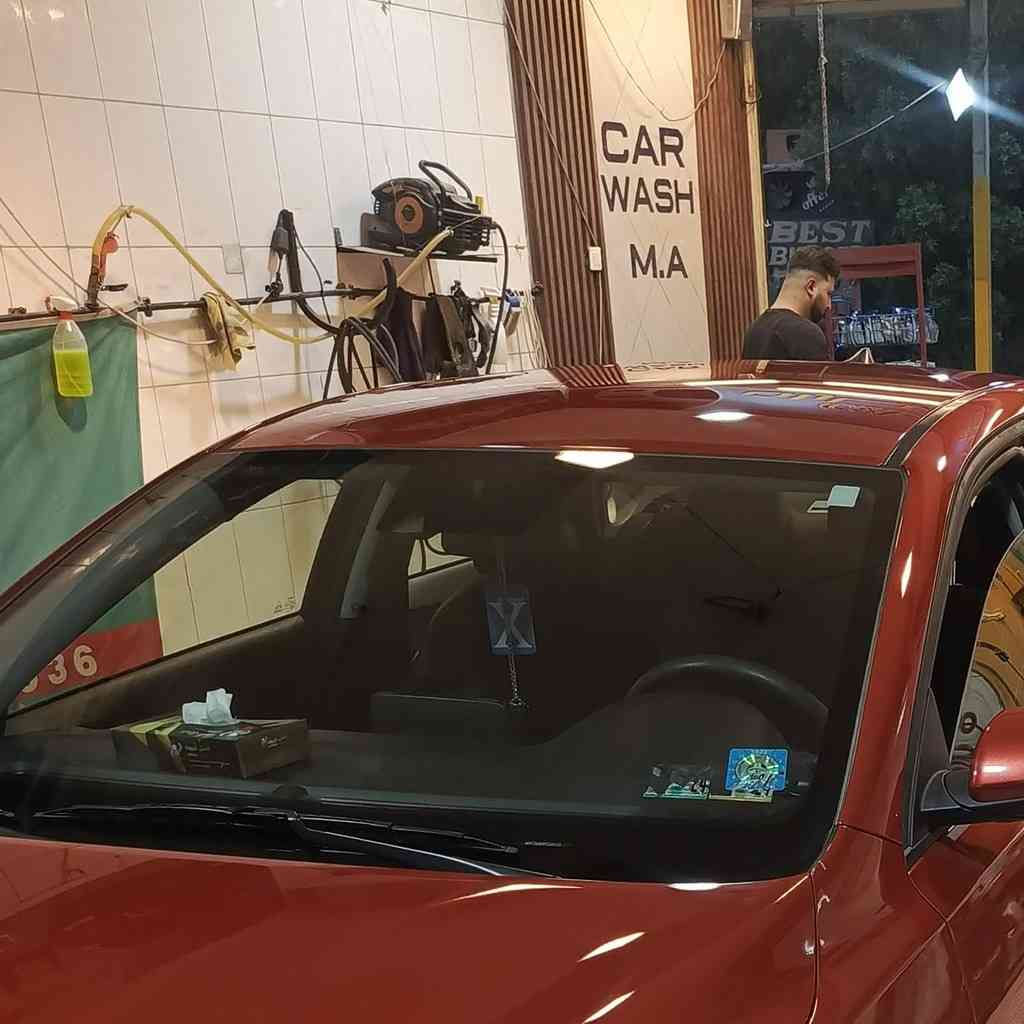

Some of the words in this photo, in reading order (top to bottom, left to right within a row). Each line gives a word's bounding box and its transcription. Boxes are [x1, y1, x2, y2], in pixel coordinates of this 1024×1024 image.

[601, 121, 685, 168] CAR
[600, 174, 695, 214] WASH
[769, 220, 872, 243] BEST
[629, 243, 688, 279] M.A
[22, 644, 98, 694] 36
